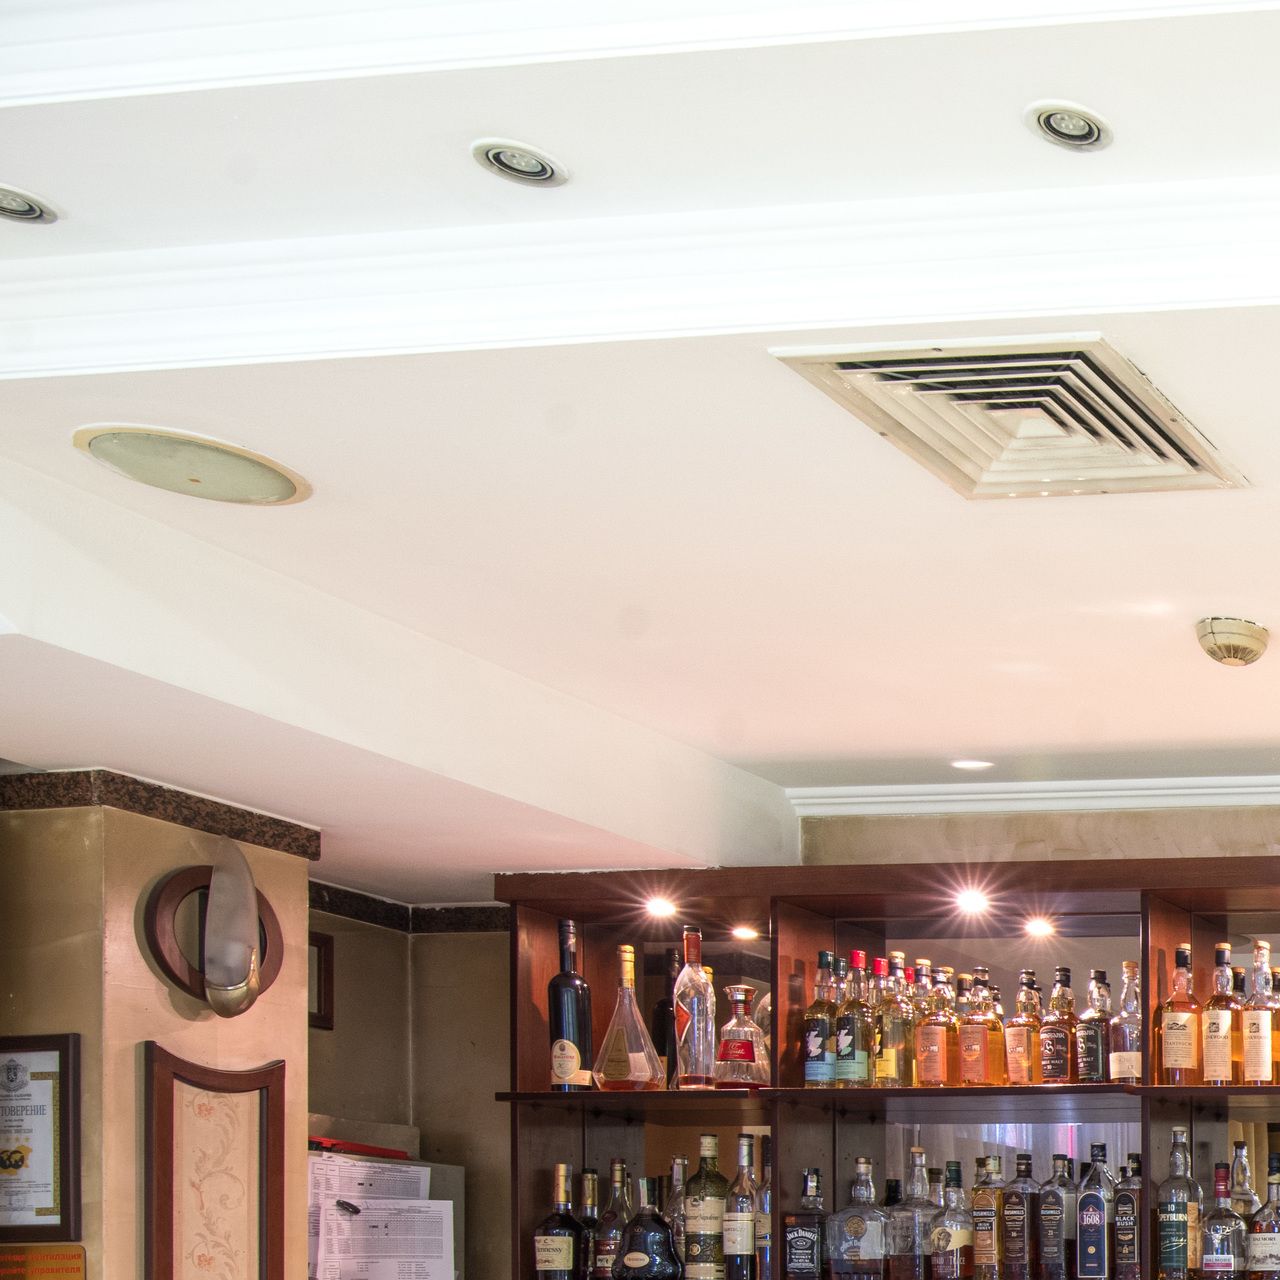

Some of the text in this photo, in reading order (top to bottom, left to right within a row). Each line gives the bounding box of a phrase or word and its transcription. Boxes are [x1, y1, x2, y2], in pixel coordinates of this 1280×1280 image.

[1167, 1203, 1175, 1211] 10
[1083, 1215, 1100, 1226] 1608
[787, 1230, 799, 1242] JACK
